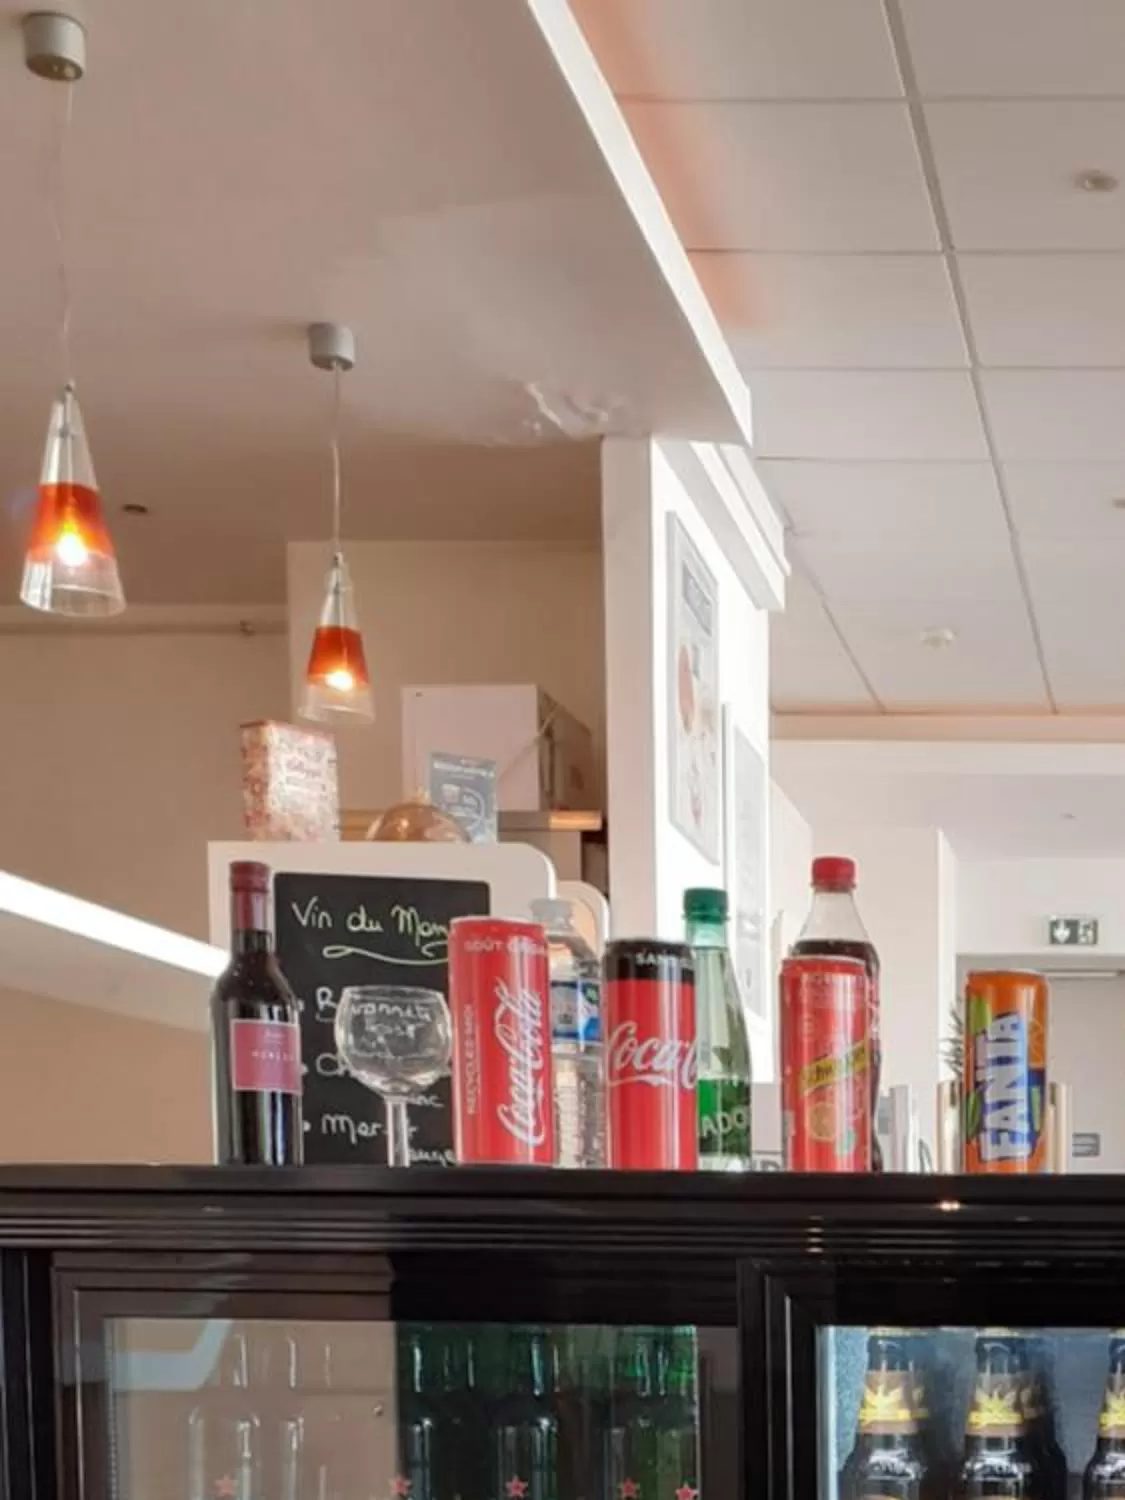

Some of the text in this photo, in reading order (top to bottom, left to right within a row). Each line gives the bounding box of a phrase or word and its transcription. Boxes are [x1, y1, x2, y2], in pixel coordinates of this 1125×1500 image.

[292, 896, 333, 929] Vin
[346, 905, 384, 933] du
[977, 1012, 1030, 1162] FANTA
